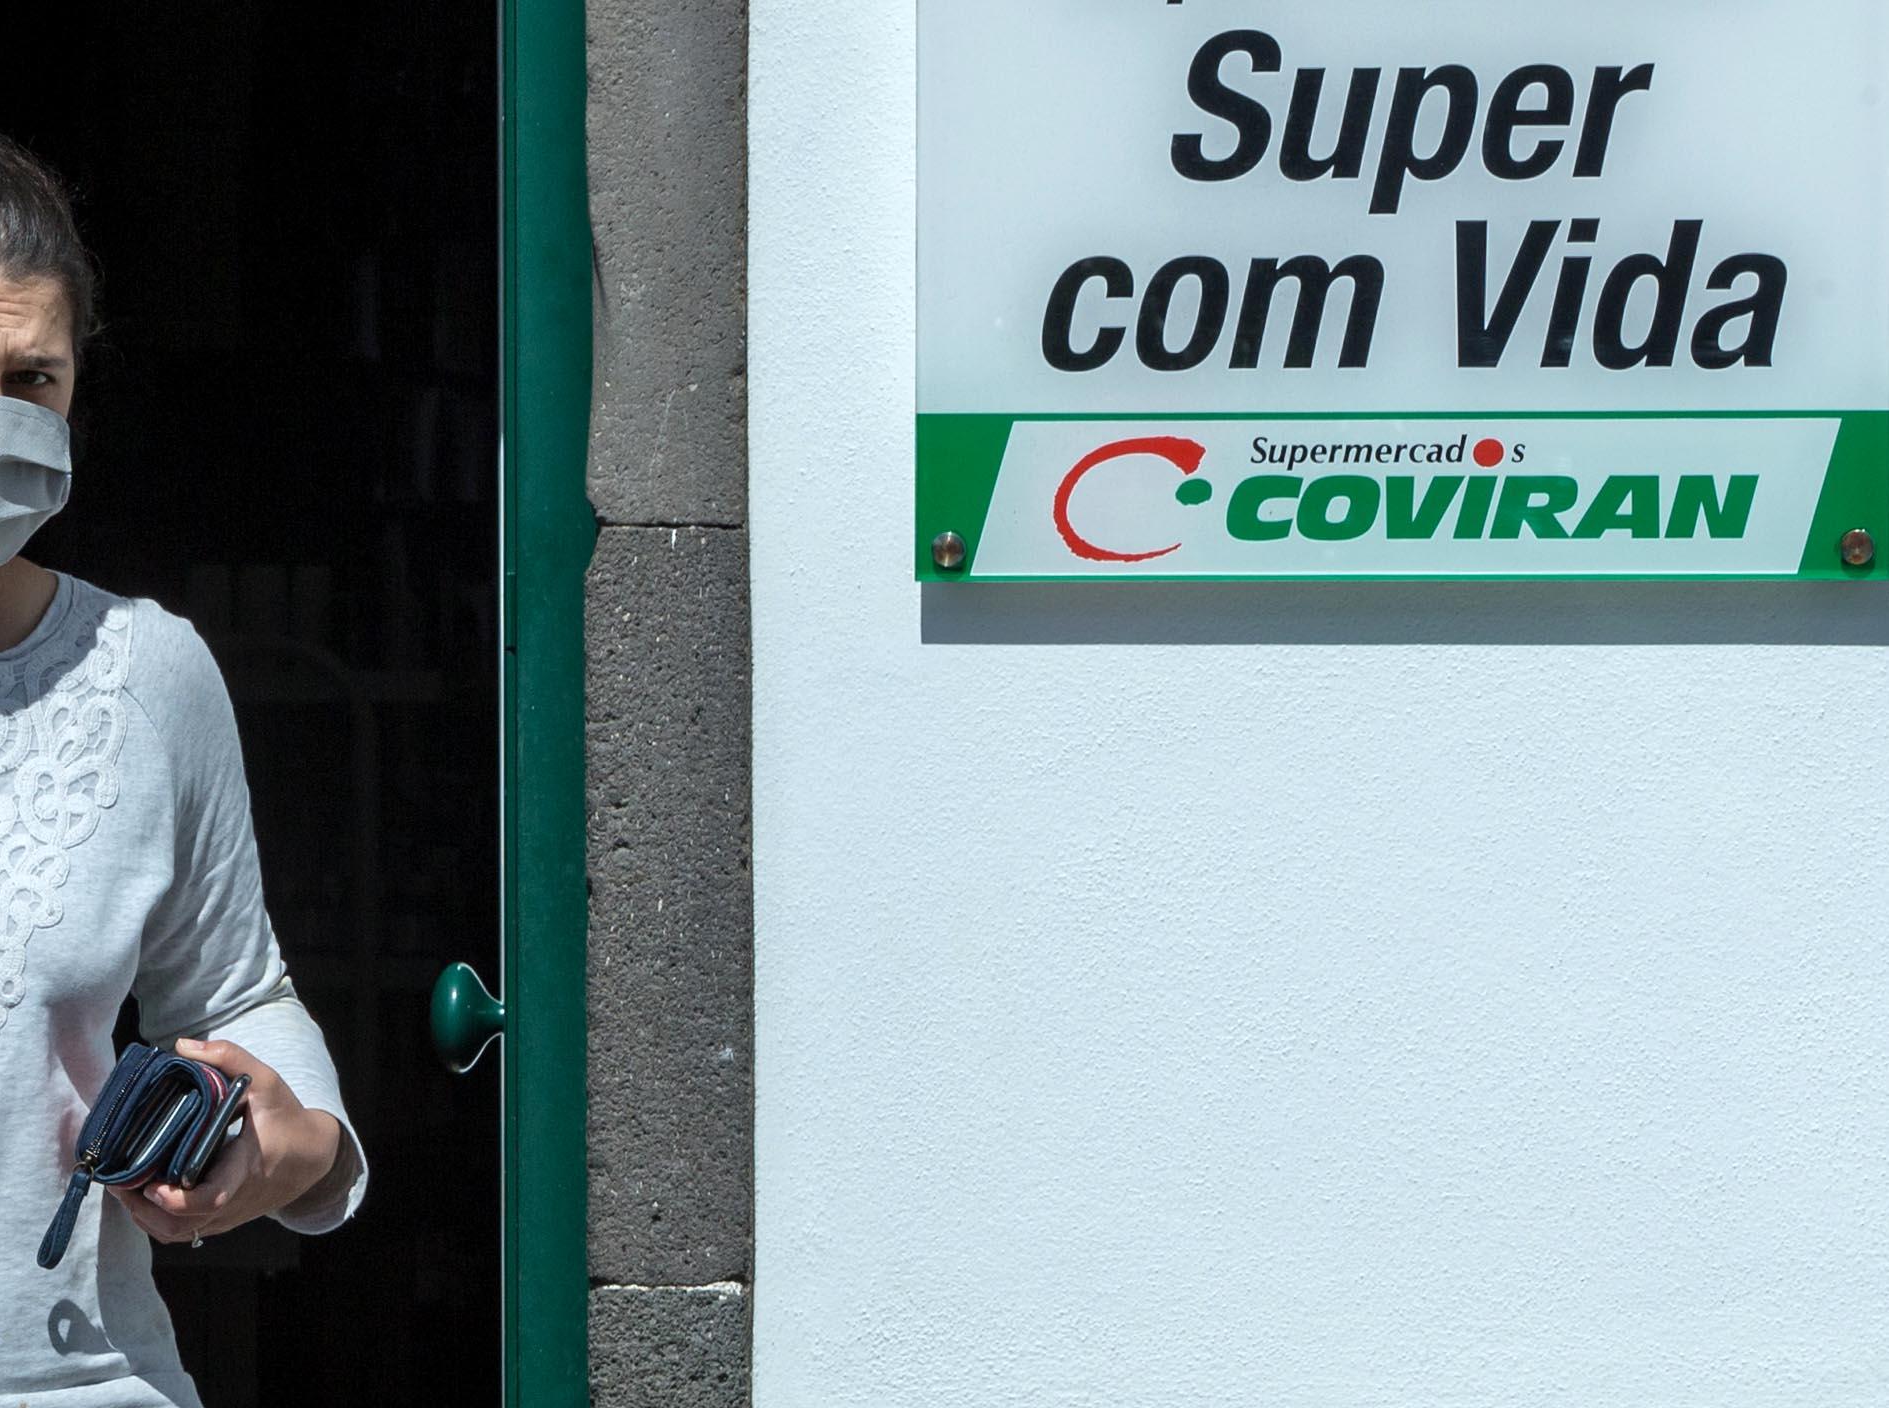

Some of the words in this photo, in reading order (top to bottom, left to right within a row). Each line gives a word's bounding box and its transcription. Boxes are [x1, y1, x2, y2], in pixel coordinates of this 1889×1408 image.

[1170, 29, 1655, 214] Super
[1041, 254, 1386, 371] com
[1456, 218, 1788, 370] Vida
[1226, 473, 1760, 541] COVIRAN
